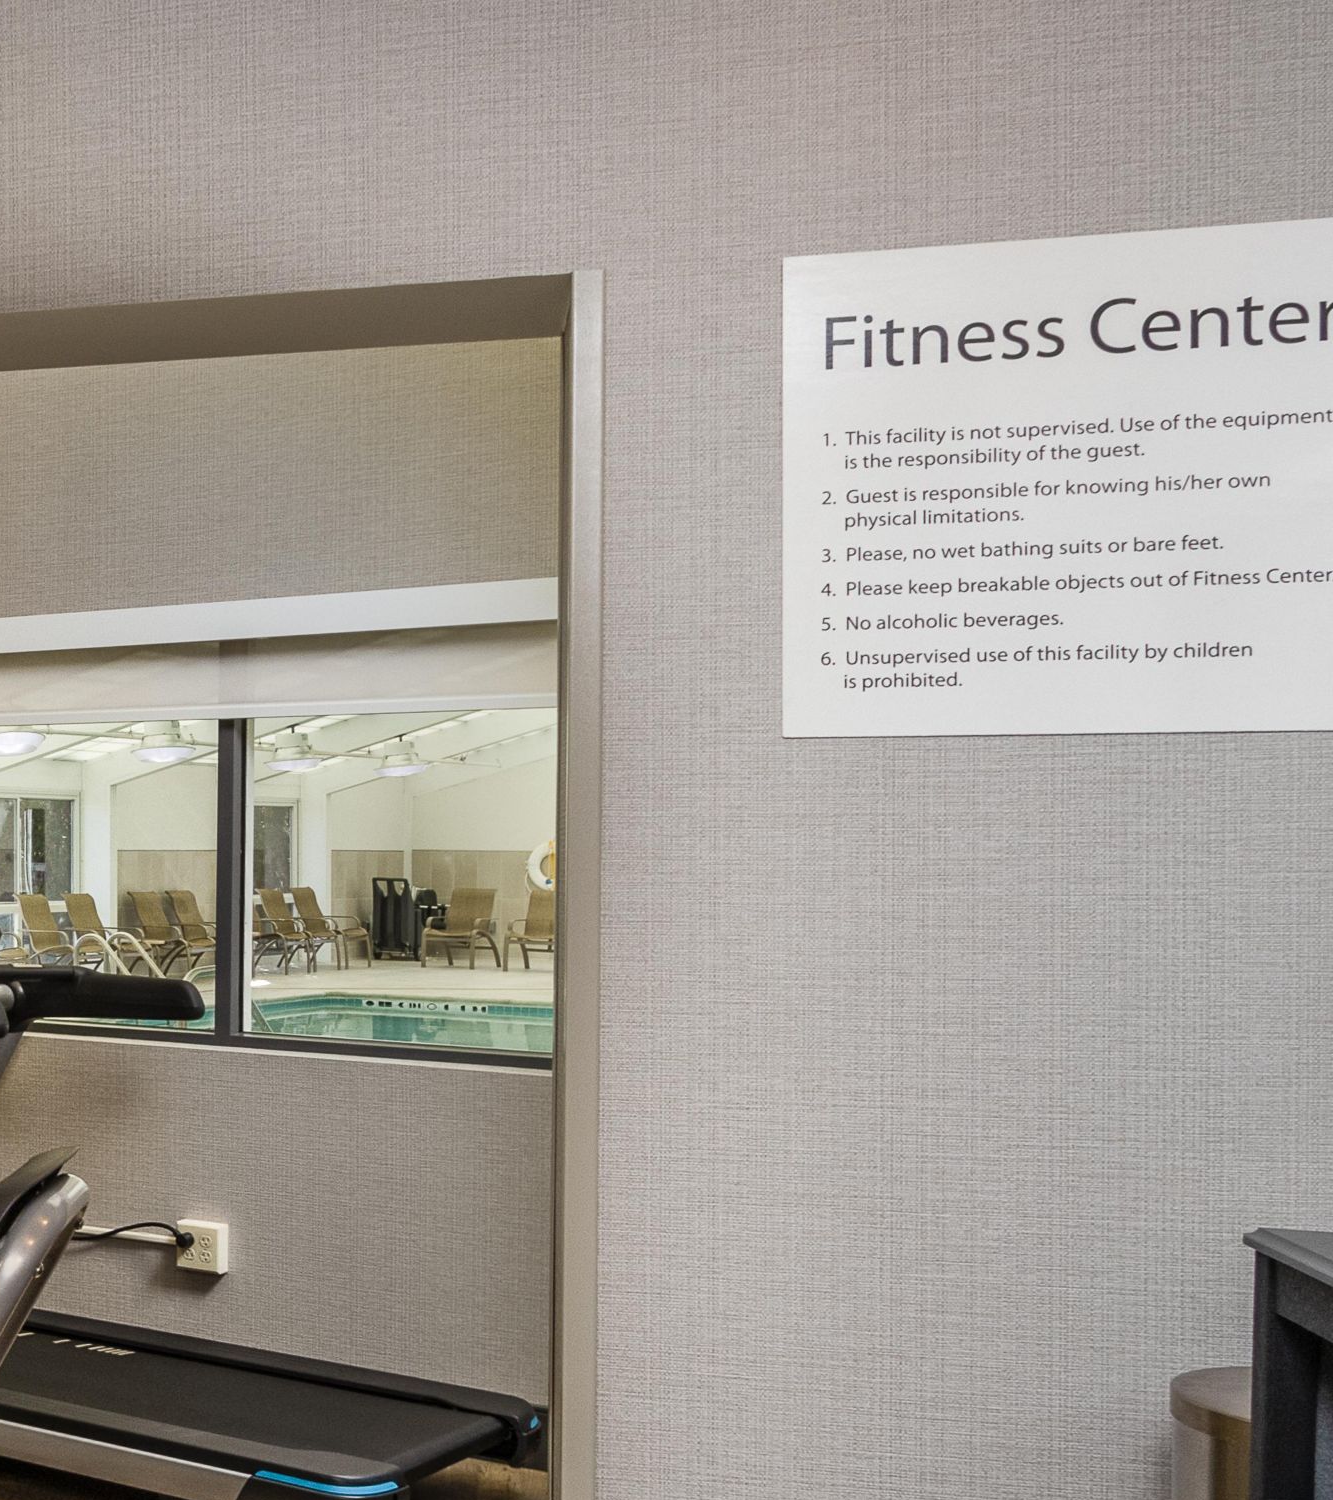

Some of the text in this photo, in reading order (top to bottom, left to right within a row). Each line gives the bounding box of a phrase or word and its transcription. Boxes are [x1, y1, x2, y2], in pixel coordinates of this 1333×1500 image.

[825, 296, 1333, 371] Fitness Center
[823, 409, 1333, 447] 1. This facility is not supervised. Use of the equipment
[844, 443, 1145, 470] is the responsibility of the guest.
[821, 474, 1271, 505] 2. Guest is responsible for knowing his/her own
[844, 507, 1025, 532] physical limitations.
[821, 534, 1224, 563] 3. Please, no wet bathing suits or bare feet.
[820, 582, 837, 597] 4.
[846, 580, 903, 597] Please
[908, 578, 953, 598] keep
[958, 575, 1051, 593] breakable
[1055, 573, 1125, 594] objects
[1129, 573, 1164, 588] out
[1168, 570, 1190, 587] of
[1193, 570, 1261, 586] Fitness
[821, 612, 1064, 632] 5. No alcoholic beverages.
[820, 641, 1253, 668] 6. Unsupervised use of this facility by children
[844, 671, 963, 693] is prohibited.
